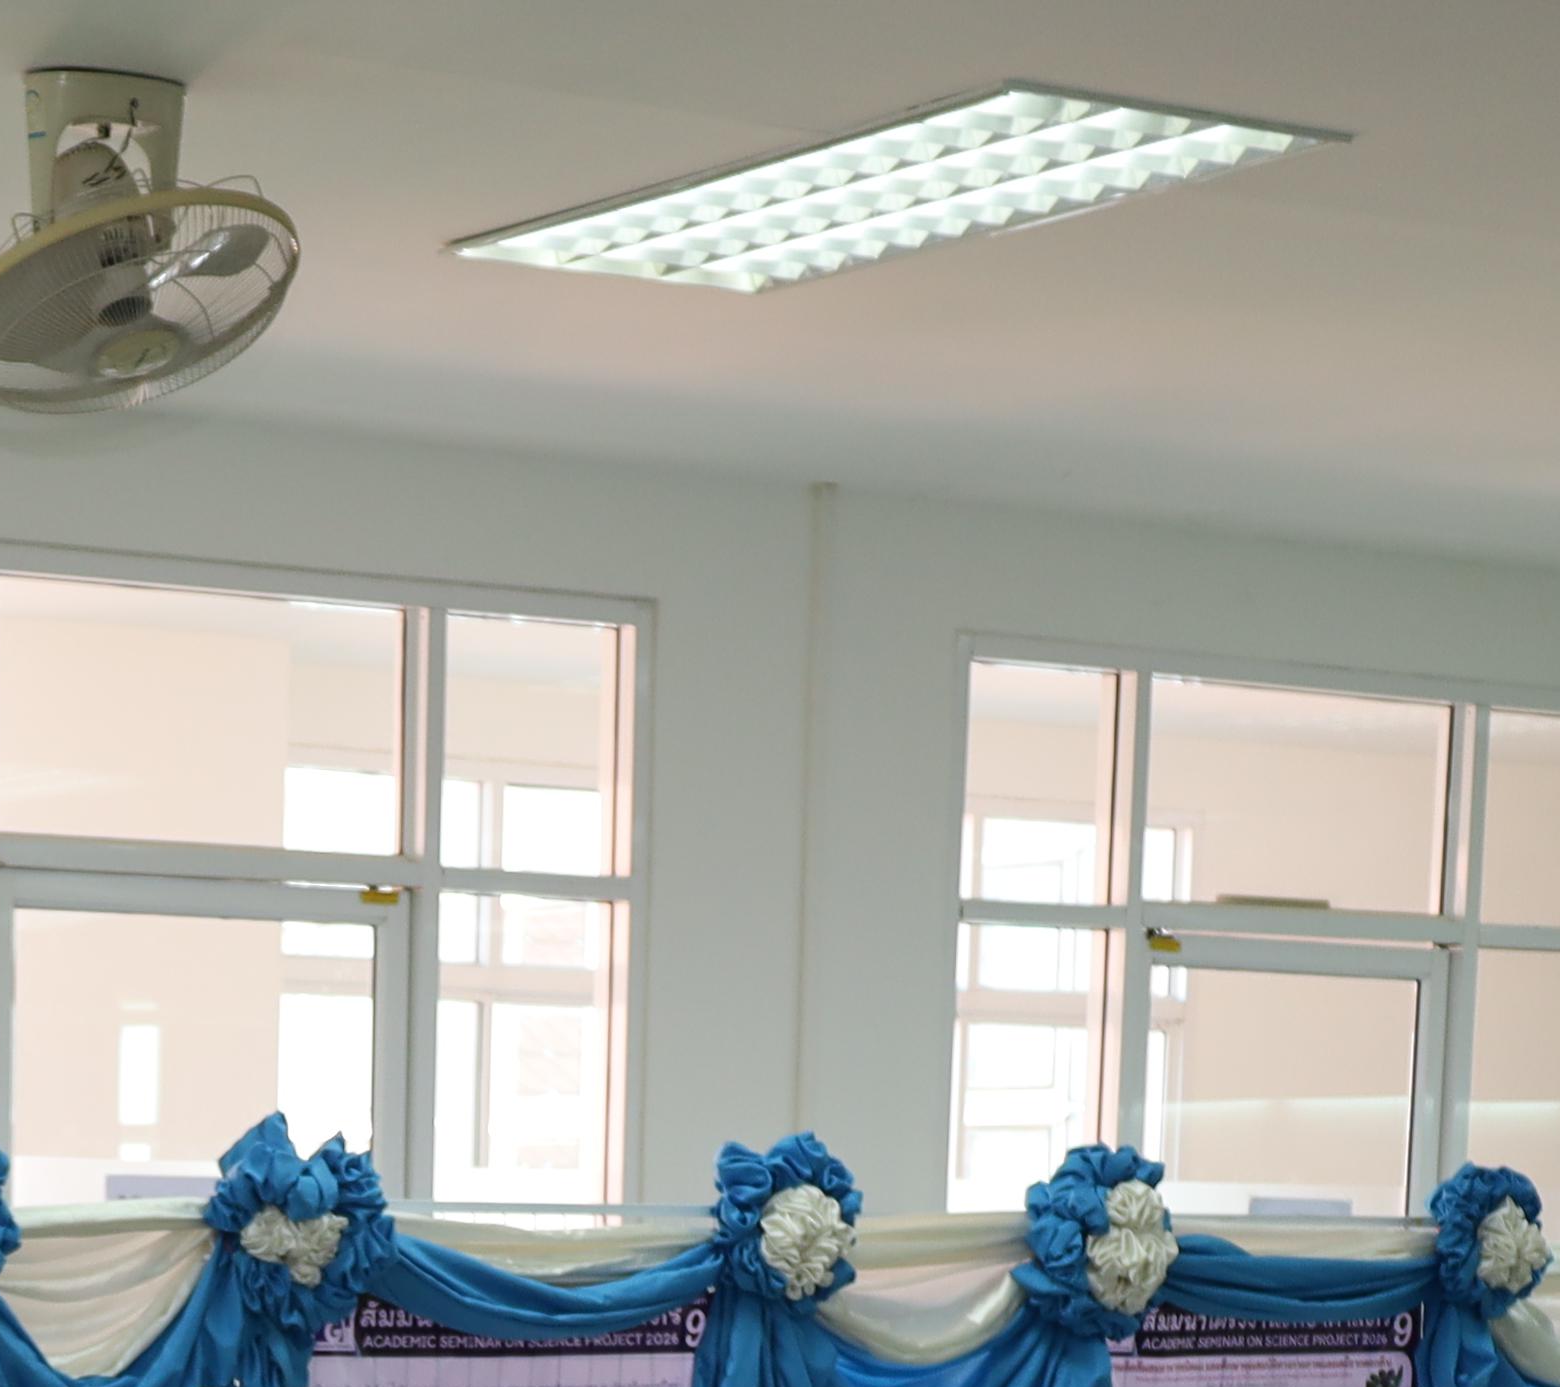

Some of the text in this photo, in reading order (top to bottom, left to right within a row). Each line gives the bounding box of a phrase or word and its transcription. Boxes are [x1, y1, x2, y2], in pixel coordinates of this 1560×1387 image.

[363, 1335, 436, 1348] ACADEMIC
[645, 1332, 679, 1346] 2026
[685, 1309, 706, 1348] 9
[1197, 1336, 1245, 1349] SEMINAR
[1247, 1335, 1263, 1347] ON
[1265, 1334, 1310, 1347] SCIENCE
[1312, 1333, 1360, 1347] PROJECT
[1362, 1333, 1388, 1346] 2026
[1393, 1312, 1413, 1347] 9
